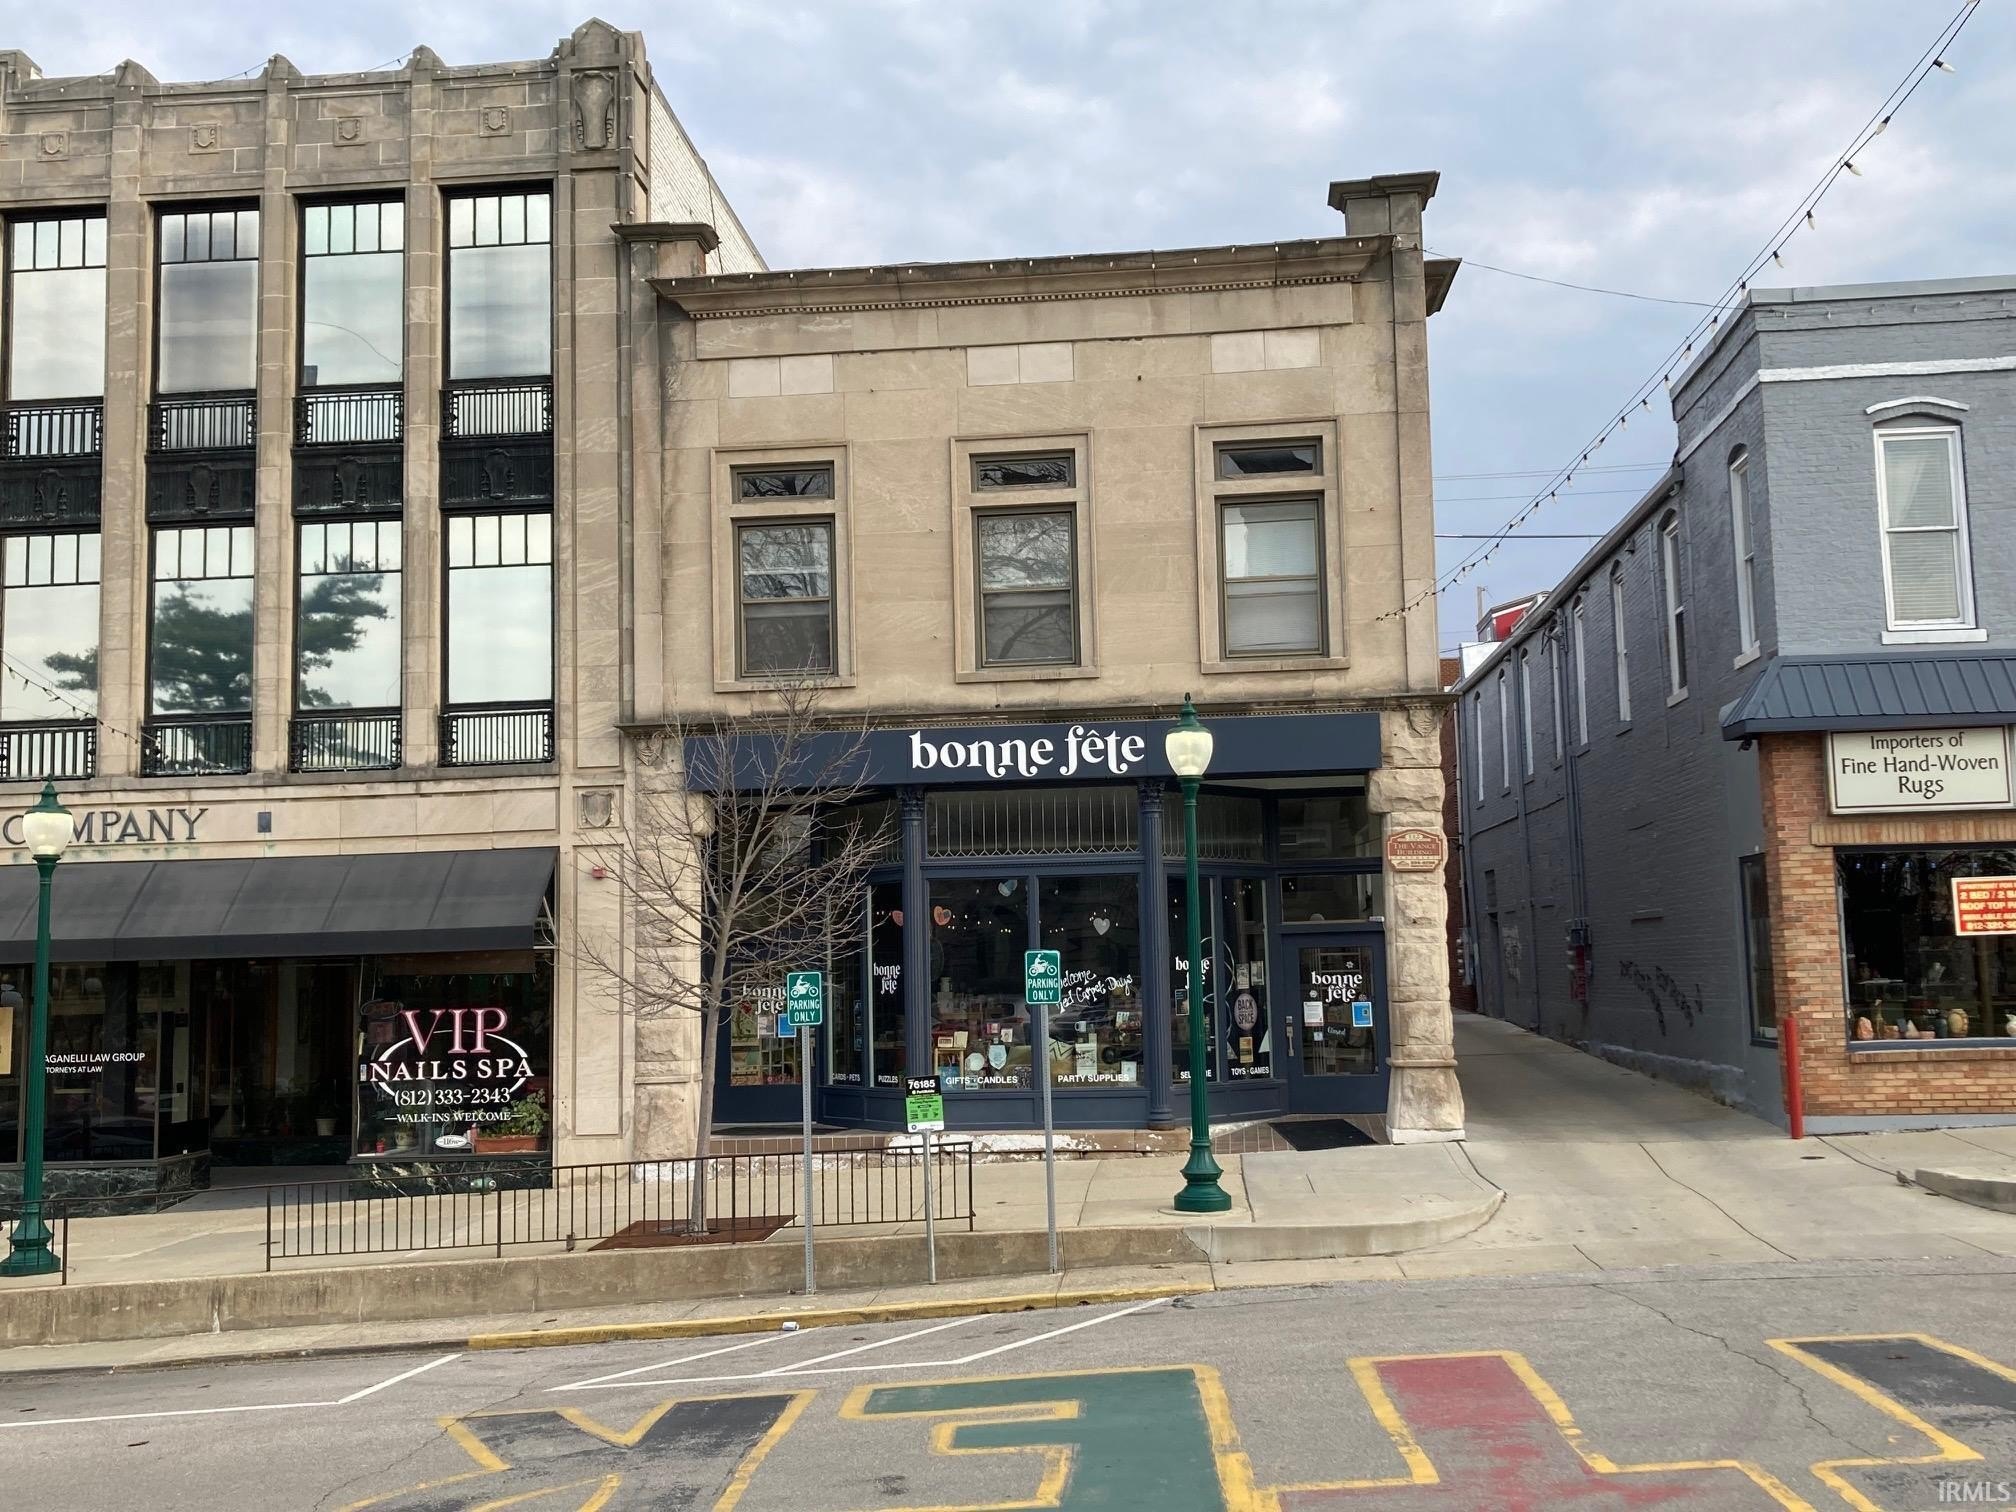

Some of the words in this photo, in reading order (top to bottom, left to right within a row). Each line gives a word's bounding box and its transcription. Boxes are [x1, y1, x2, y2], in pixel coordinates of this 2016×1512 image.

[1870, 733, 1943, 754] Importers
[1947, 731, 1966, 748] of
[909, 730, 1054, 778] bonne
[1059, 725, 1146, 776] fête
[1841, 757, 1877, 775] Fine
[1883, 752, 1999, 774] Hand-Woven
[1898, 775, 1944, 800] Rugs
[2, 808, 209, 845] CMPANY
[1959, 891, 1968, 900] 2
[873, 962, 901, 980] bonne
[1027, 978, 1058, 989] PARKING
[1060, 969, 1097, 989] elcome
[1105, 974, 1133, 996] Days
[1311, 971, 1363, 988] bonne
[1032, 989, 1054, 1001] ONLY
[1325, 984, 1356, 1003] fête
[789, 999, 820, 1010] PARKING
[1237, 999, 1254, 1011] BACK
[794, 1011, 816, 1022] ONLY
[1238, 1013, 1254, 1025] SPACE
[400, 1007, 508, 1055] VIP
[44, 1054, 88, 1064] AGANELLI
[90, 1053, 111, 1063] LAW
[112, 1052, 146, 1062] GROUP
[369, 1059, 468, 1082] NAILS
[477, 1056, 535, 1078] SPA
[1230, 1067, 1246, 1076] TOYS
[1249, 1066, 1270, 1075] GAMES
[878, 1075, 899, 1084] PUZZLES
[945, 1076, 970, 1085] GIFTS
[977, 1076, 1018, 1084] CANDLES
[1057, 1074, 1085, 1083] PARTY
[1087, 1074, 1130, 1083] SUPPLIES
[907, 1080, 936, 1090] 76185
[394, 1088, 432, 1106] (812)
[435, 1087, 511, 1105] 333-2343
[397, 1112, 450, 1123] WALK-INS
[453, 1111, 513, 1122] WELCOME
